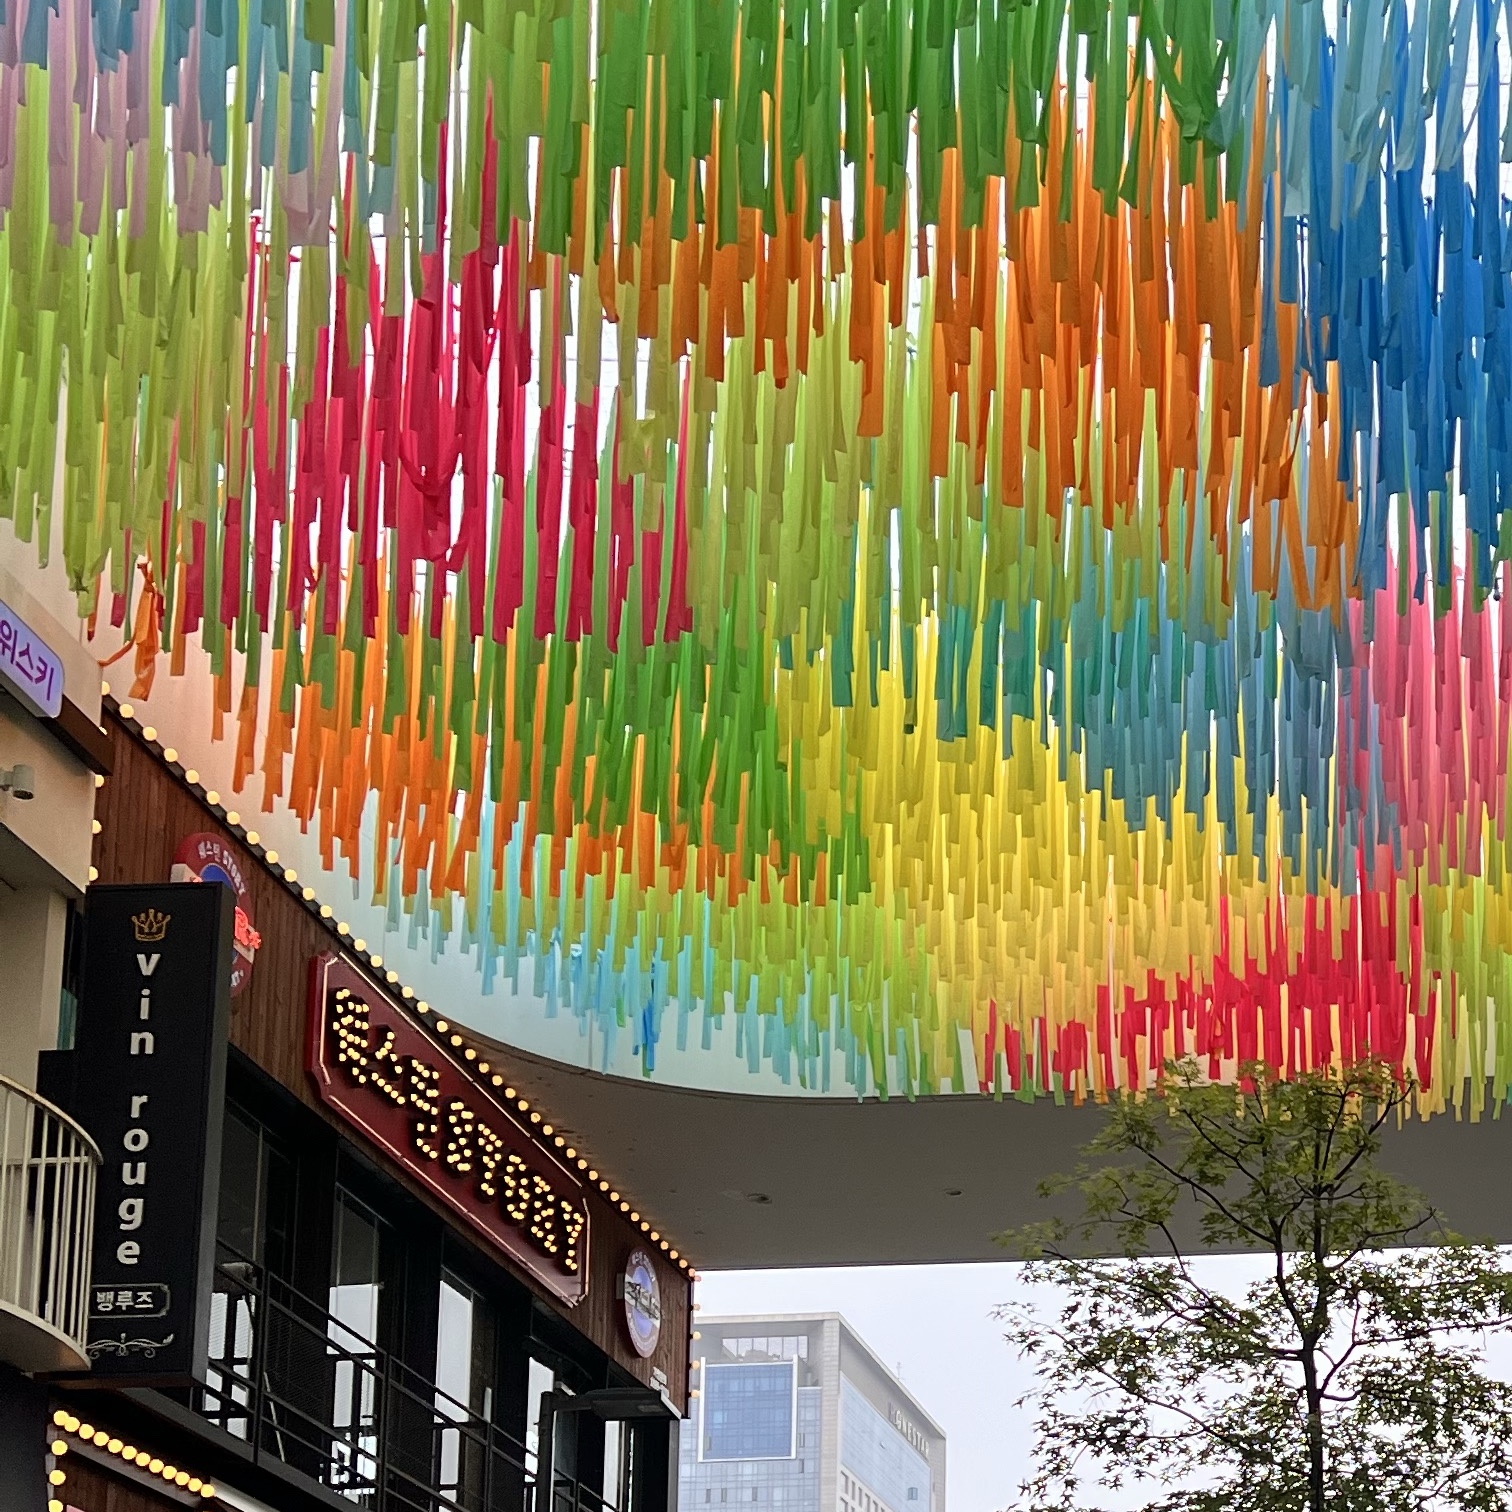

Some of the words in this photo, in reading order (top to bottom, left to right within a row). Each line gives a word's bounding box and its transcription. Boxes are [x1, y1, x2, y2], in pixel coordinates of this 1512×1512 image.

[0, 619, 54, 702] 위스키
[130, 953, 161, 1055] vin
[116, 1094, 150, 1265] rouge
[96, 1290, 155, 1311] 뱅루즈
